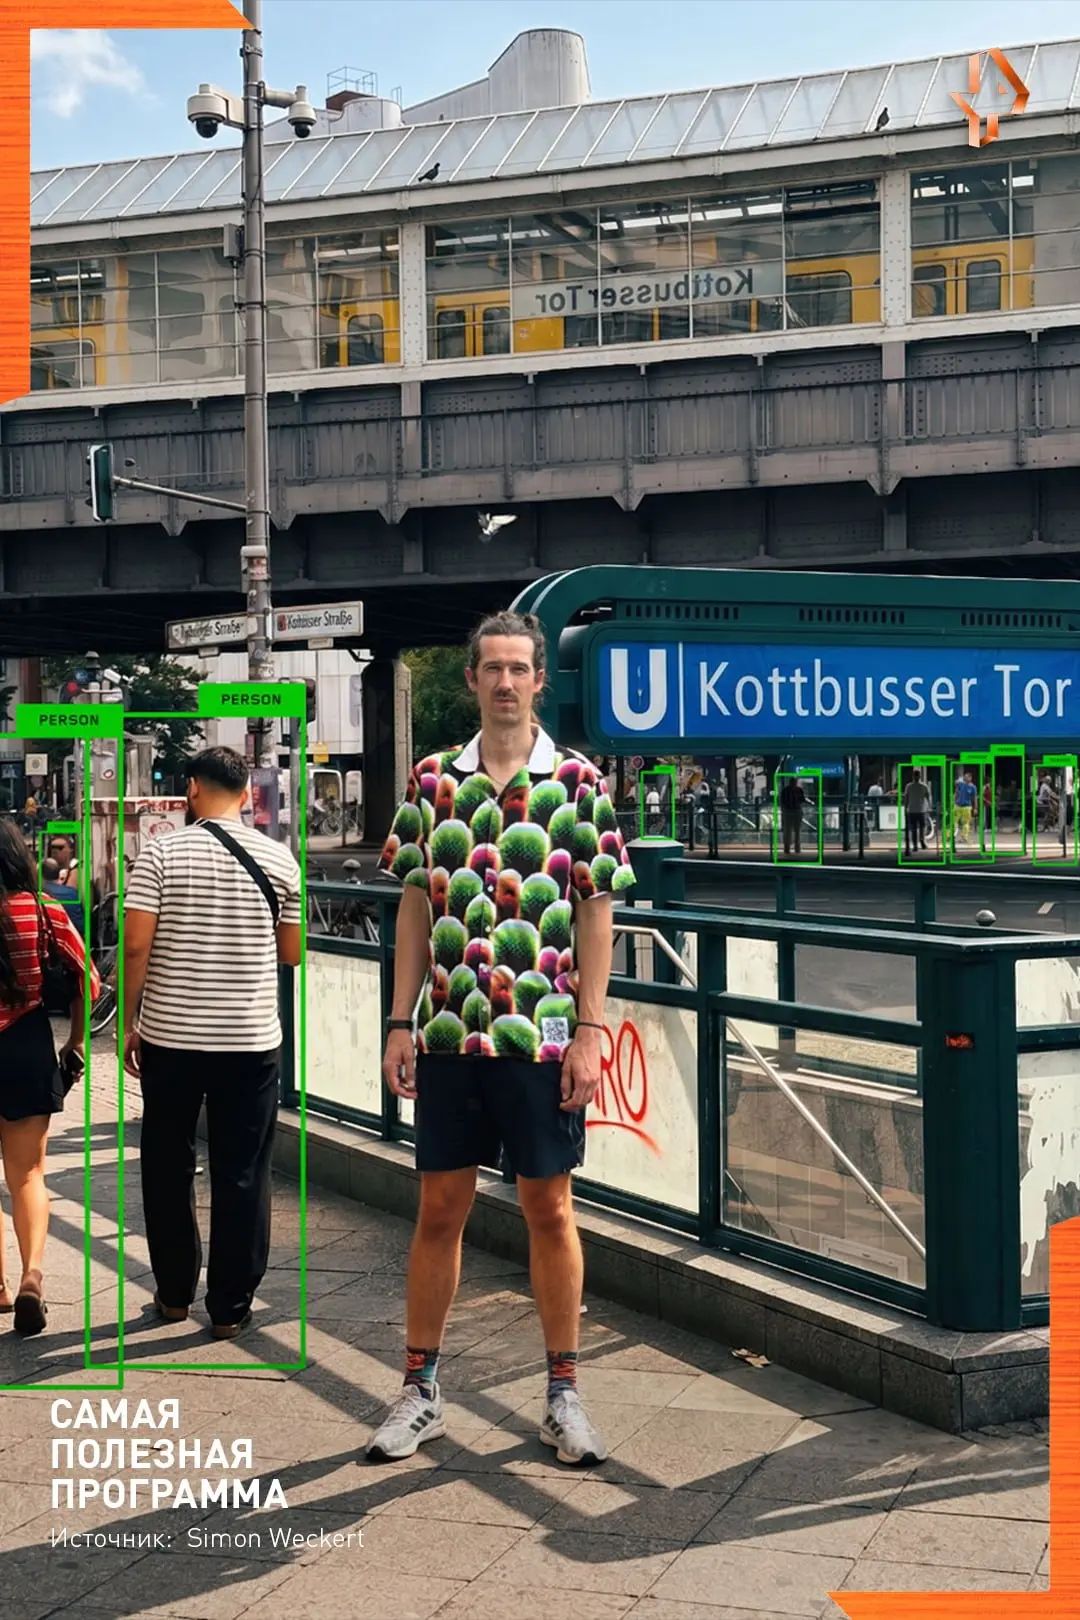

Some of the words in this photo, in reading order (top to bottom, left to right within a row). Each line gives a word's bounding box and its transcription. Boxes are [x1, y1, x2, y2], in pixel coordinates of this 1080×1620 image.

[611, 649, 667, 731] U
[699, 658, 977, 717] Kottbusser
[994, 665, 1072, 717] Tor
